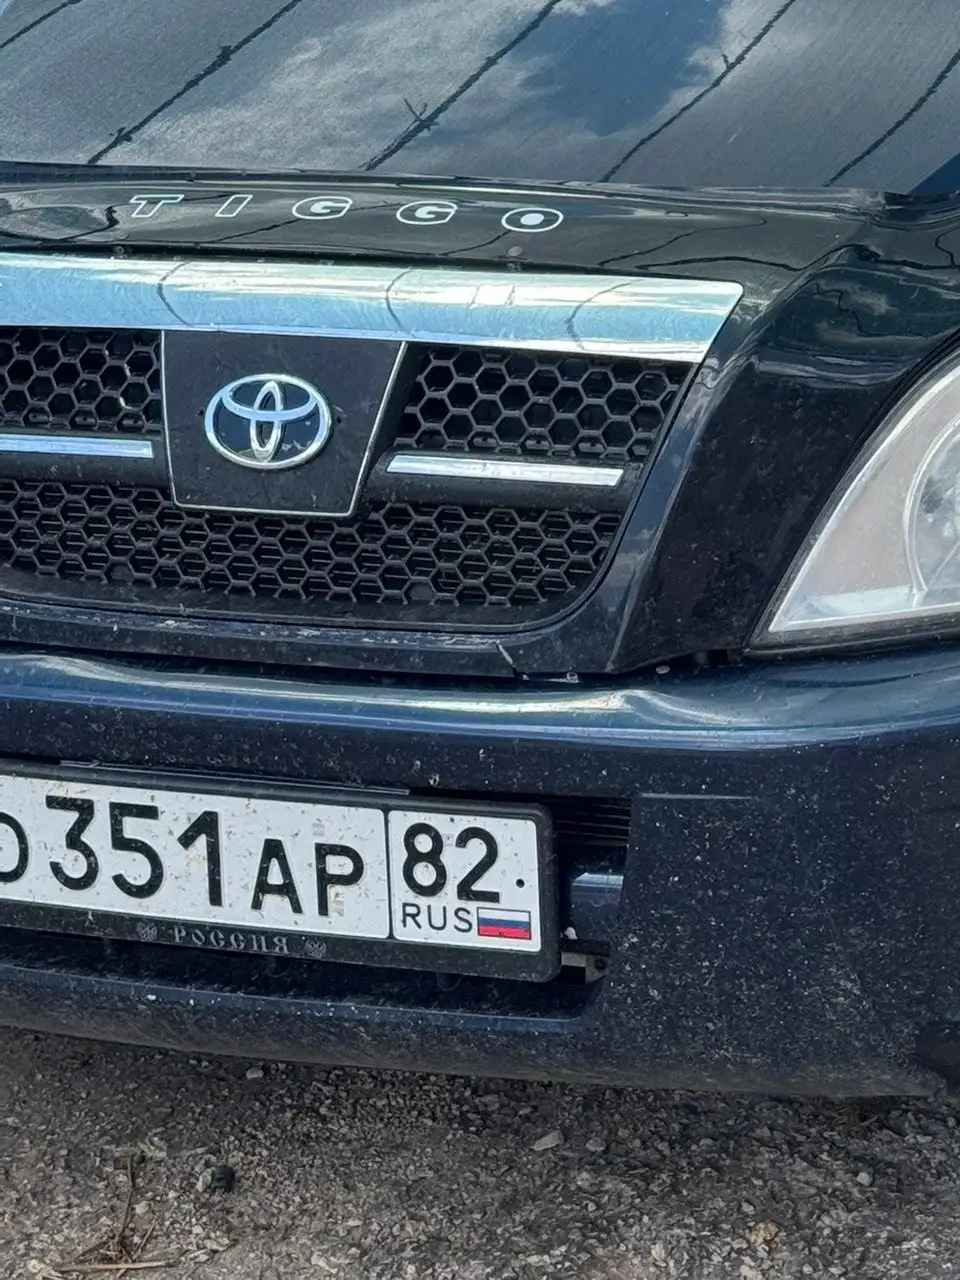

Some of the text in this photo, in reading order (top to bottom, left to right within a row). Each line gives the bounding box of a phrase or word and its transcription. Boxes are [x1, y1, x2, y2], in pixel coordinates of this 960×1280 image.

[129, 194, 563, 232] TIGGO
[402, 822, 500, 904] 82
[401, 902, 473, 933] RUS
